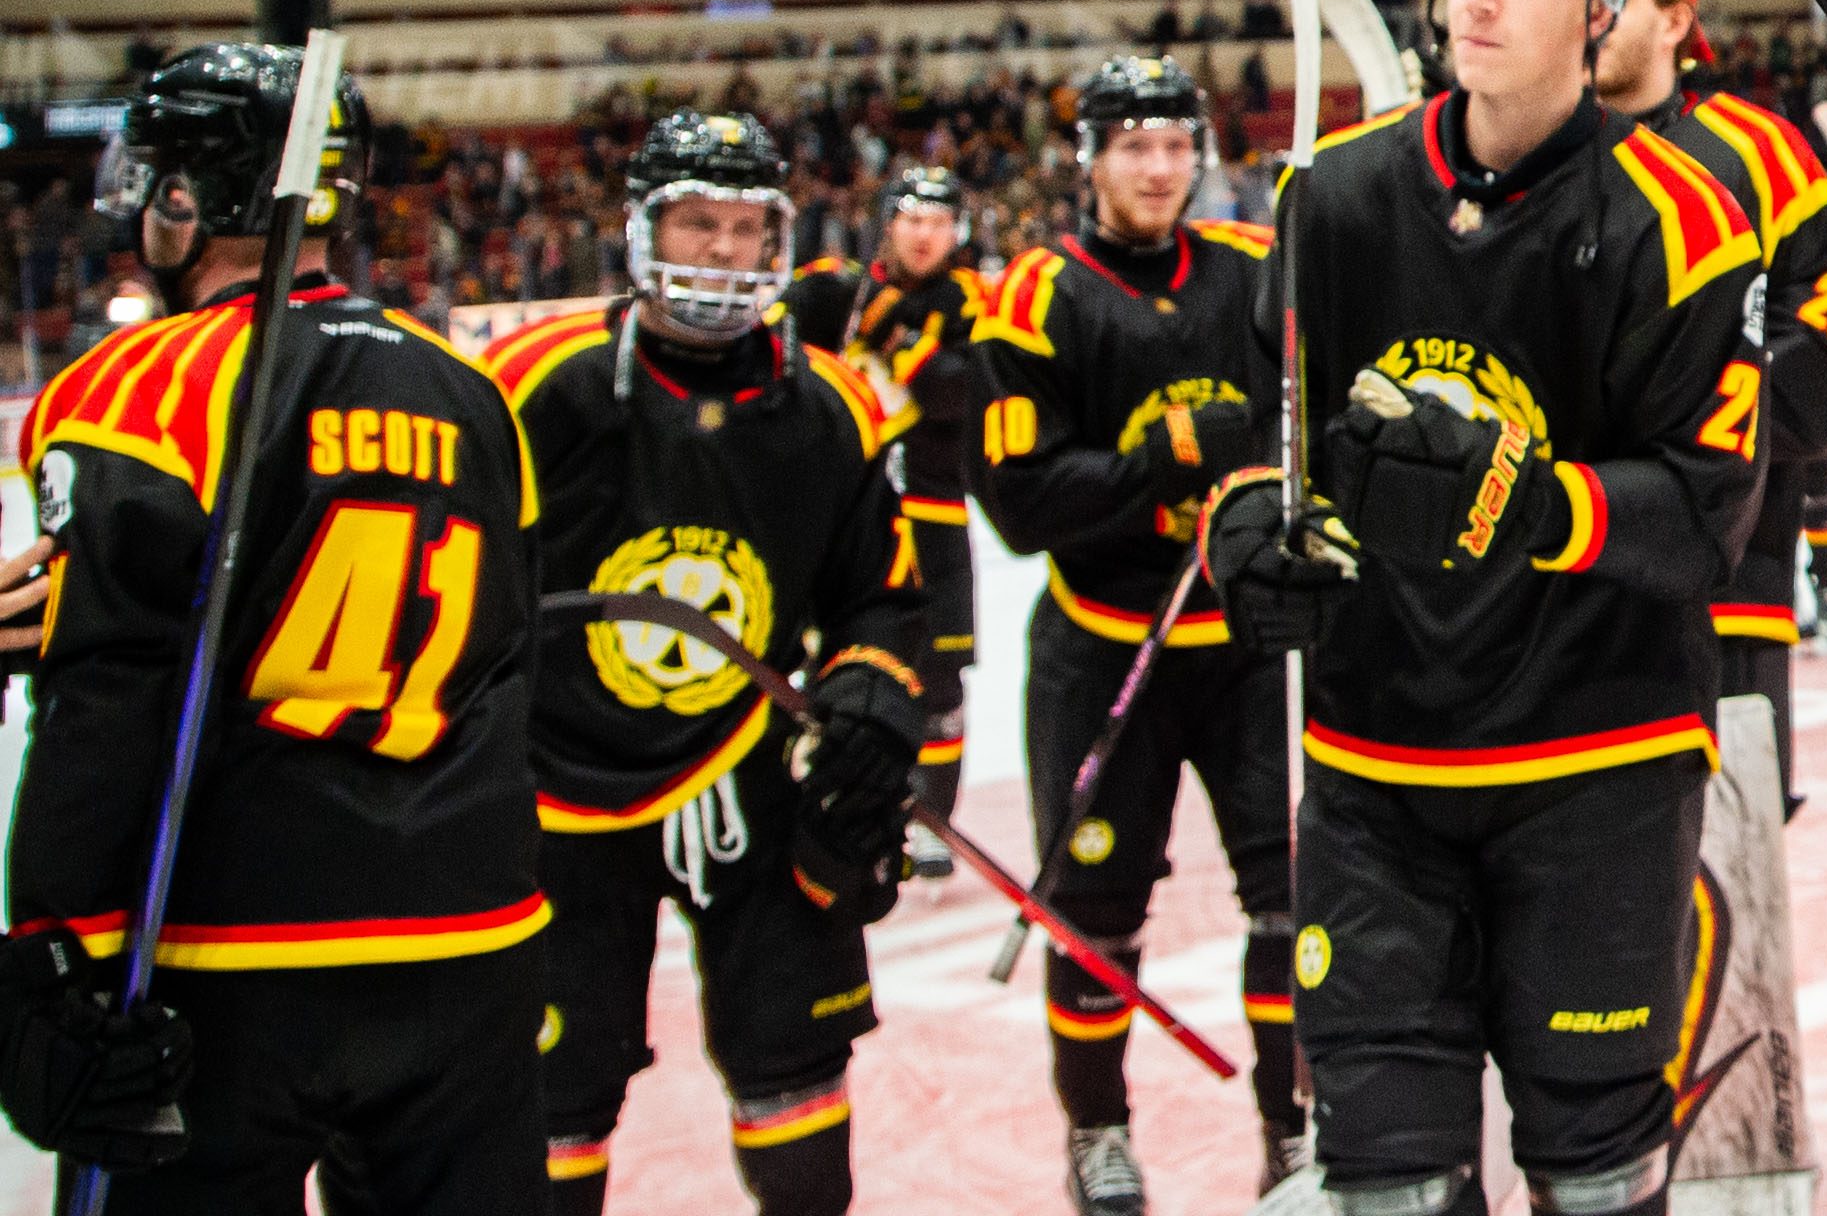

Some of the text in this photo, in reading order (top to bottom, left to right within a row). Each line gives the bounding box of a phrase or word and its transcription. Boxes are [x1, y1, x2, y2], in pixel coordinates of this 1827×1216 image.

[1412, 337, 1476, 373] 1912
[309, 409, 460, 487] SCOTT
[1697, 359, 1762, 464] 2
[243, 498, 482, 761] 41
[1547, 1006, 1651, 1034] BAUER
